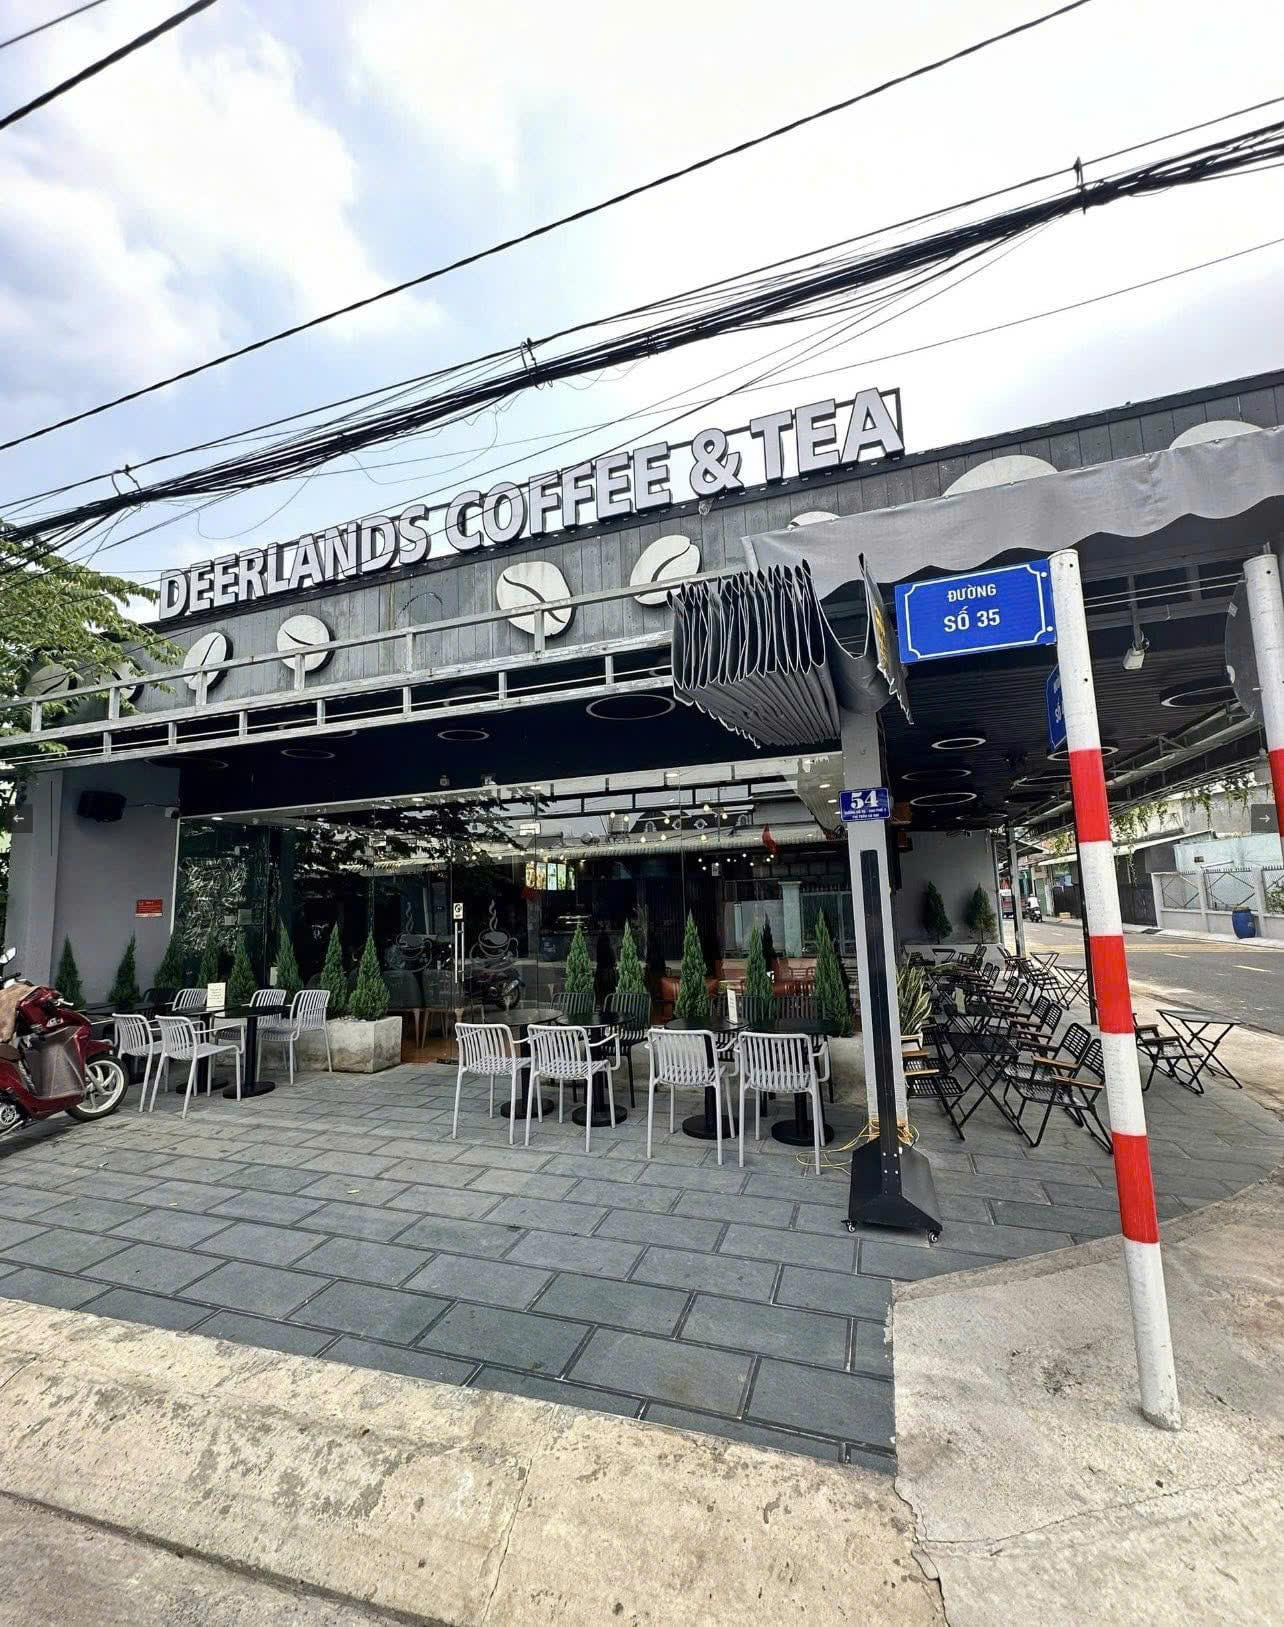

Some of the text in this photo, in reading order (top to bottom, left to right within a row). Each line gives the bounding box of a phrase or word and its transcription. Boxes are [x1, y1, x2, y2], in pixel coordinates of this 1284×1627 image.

[159, 387, 905, 620] DEERLANDS COFFEE & TEA
[947, 583, 997, 602] ĐƯỜNG
[943, 606, 1001, 632] SỐ 35
[850, 790, 879, 809] 54
